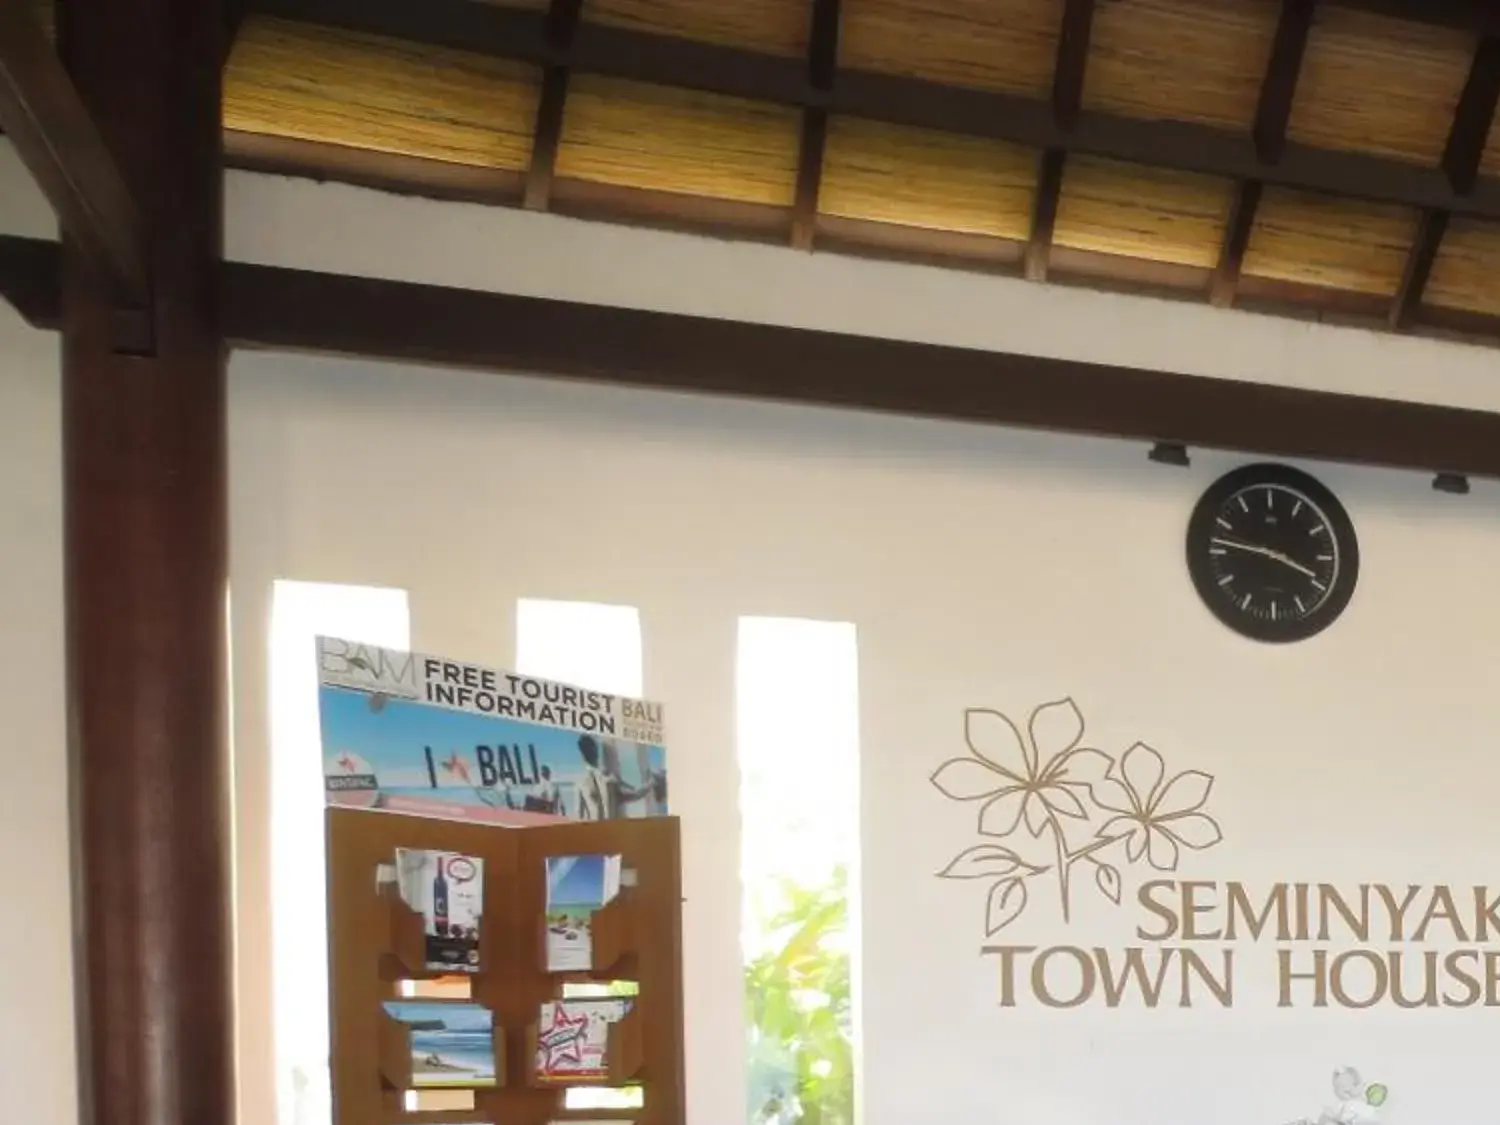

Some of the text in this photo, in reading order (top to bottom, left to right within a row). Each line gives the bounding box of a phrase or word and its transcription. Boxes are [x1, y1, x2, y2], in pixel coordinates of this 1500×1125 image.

[424, 659, 616, 713] FREE TOURIST
[426, 682, 615, 734] INFORMATION
[622, 699, 662, 724] BALI
[476, 743, 540, 787] BALI
[980, 945, 1233, 1008] TOWN
